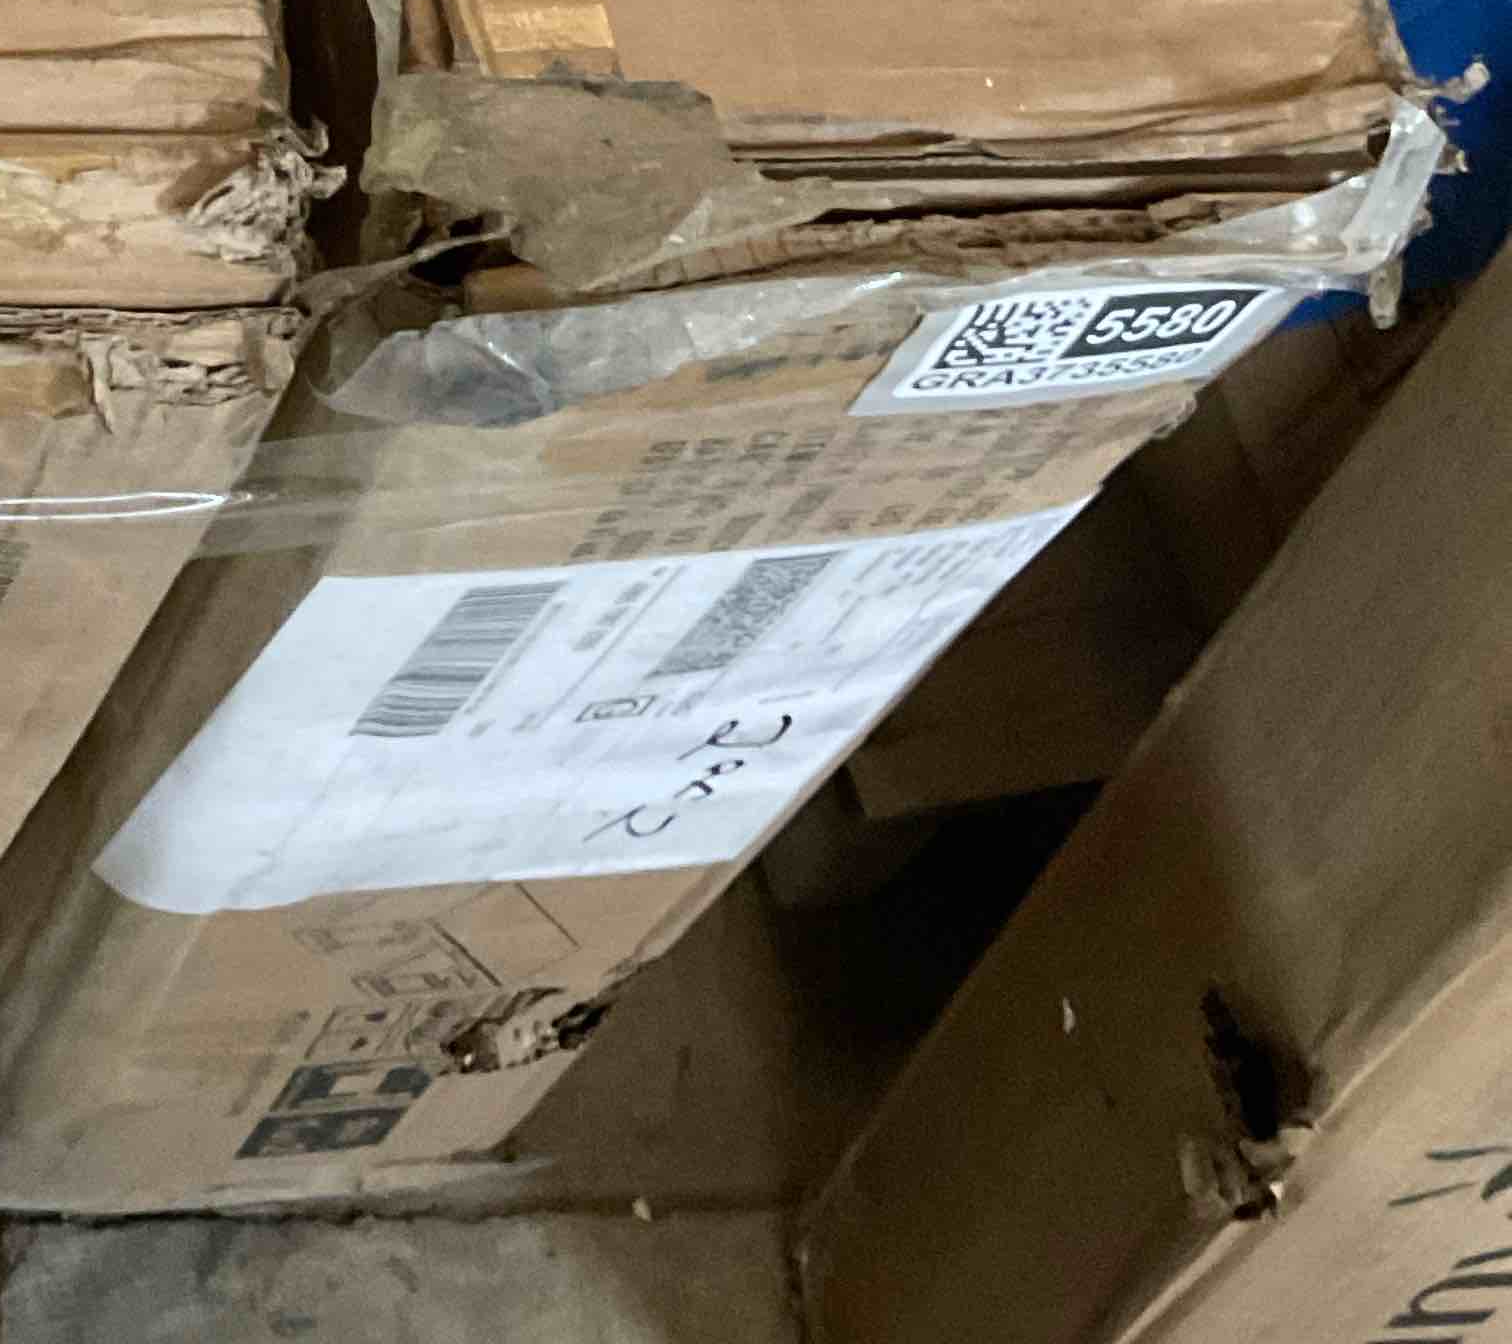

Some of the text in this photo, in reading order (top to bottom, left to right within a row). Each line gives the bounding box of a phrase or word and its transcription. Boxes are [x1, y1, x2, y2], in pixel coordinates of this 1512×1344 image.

[1087, 299, 1238, 344] 5580
[912, 348, 1204, 390] GRA3735580
[676, 714, 792, 761] 2
[582, 803, 678, 843] 2
